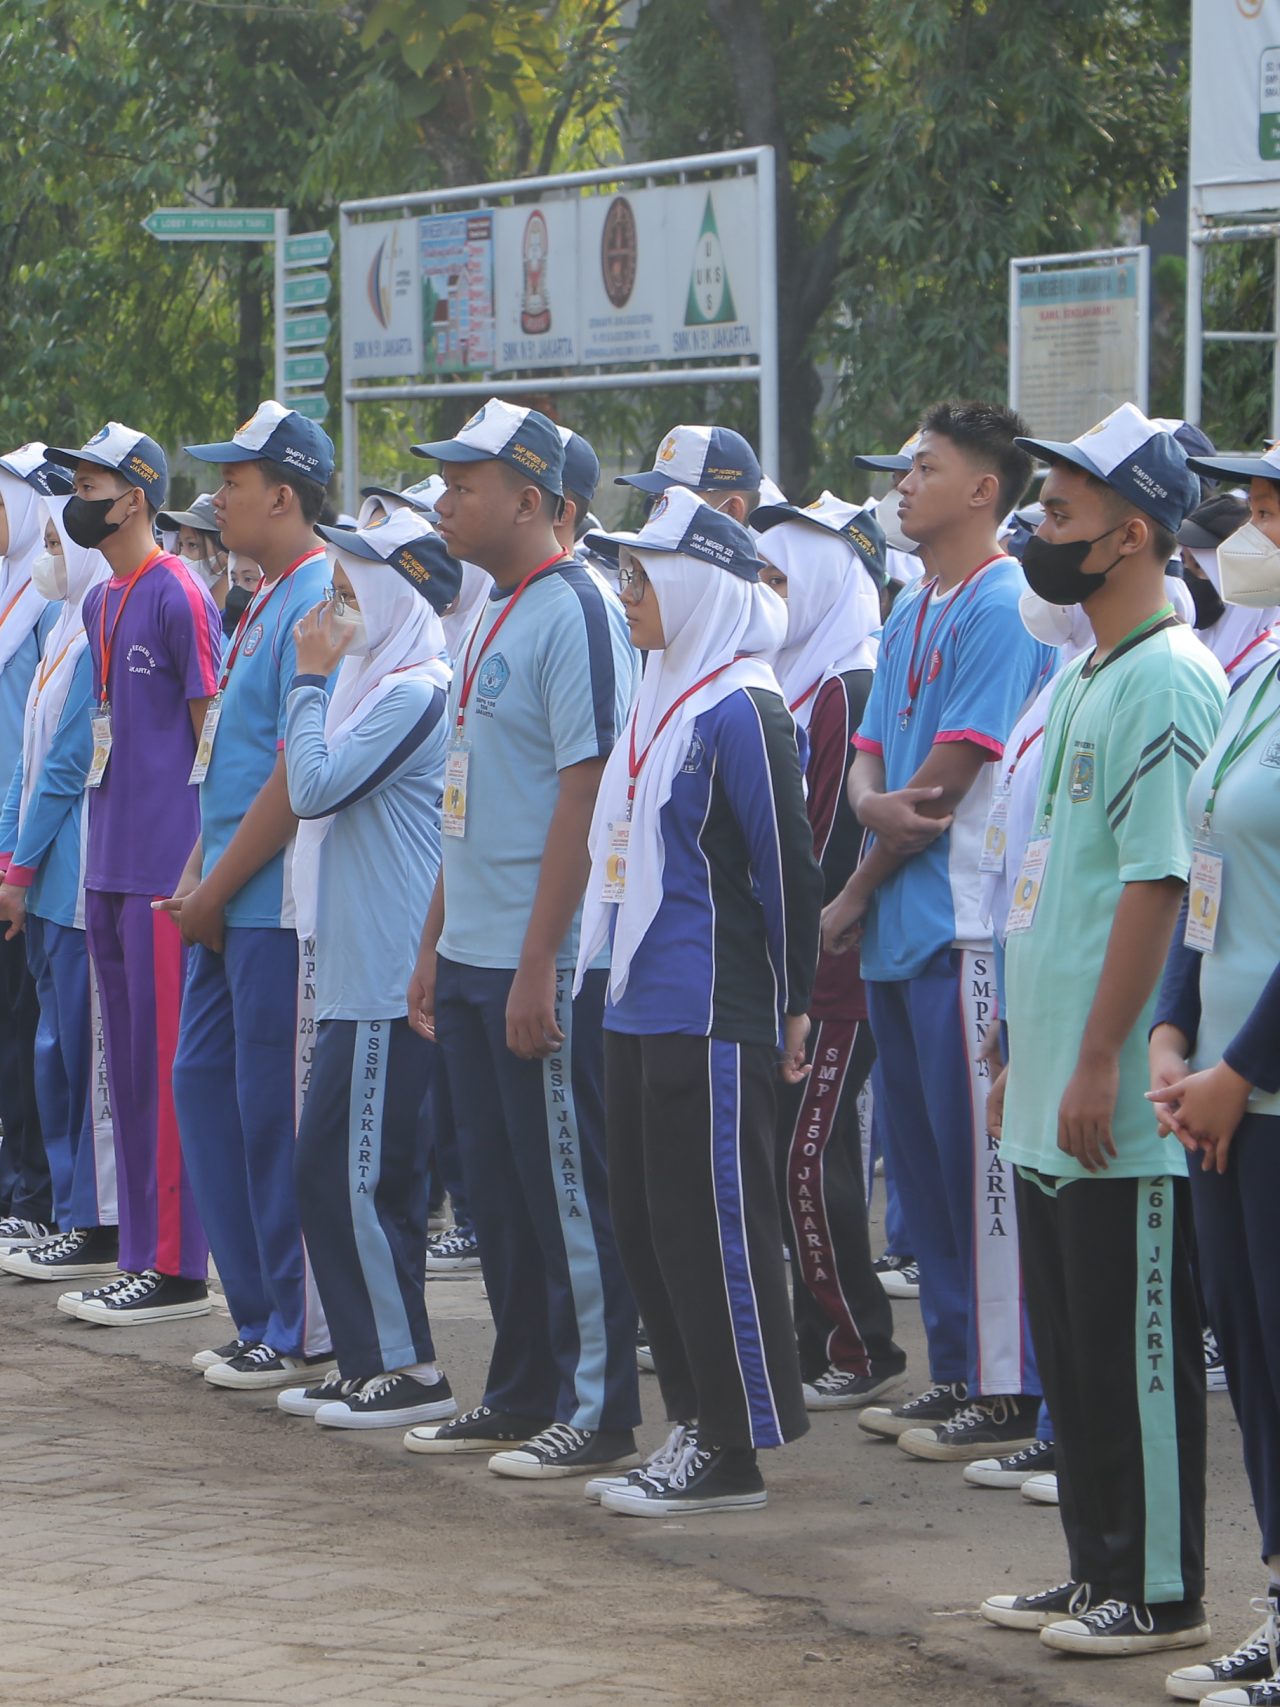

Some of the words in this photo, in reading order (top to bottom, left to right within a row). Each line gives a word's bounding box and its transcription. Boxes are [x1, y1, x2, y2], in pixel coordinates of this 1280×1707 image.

[538, 337, 574, 359] JAKARTA
[712, 324, 752, 349] JAKARTA
[285, 447, 306, 460] SMPN
[306, 456, 319, 466] 237
[512, 452, 541, 475] JAKARTA
[130, 463, 153, 484] JAKARTA
[1132, 465, 1155, 487] SMPN
[1133, 478, 1156, 499] JAKARTA
[690, 541, 714, 556] JAKARTA
[715, 552, 731, 564] TIMUR
[692, 533, 705, 542] SMP
[705, 538, 724, 552] NEGERI
[399, 559, 422, 584] JAKARTA
[972, 959, 991, 1042] SMPN
[364, 1037, 380, 1080] SSN
[550, 1059, 565, 1102] SSN
[817, 1048, 839, 1097] SMP
[357, 1088, 375, 1194] JAKARTA
[803, 1108, 821, 1156] 150
[557, 1111, 581, 1217] JAKARTA
[798, 1166, 828, 1281] JAKARTA
[1146, 1246, 1165, 1393] JAKARTA
